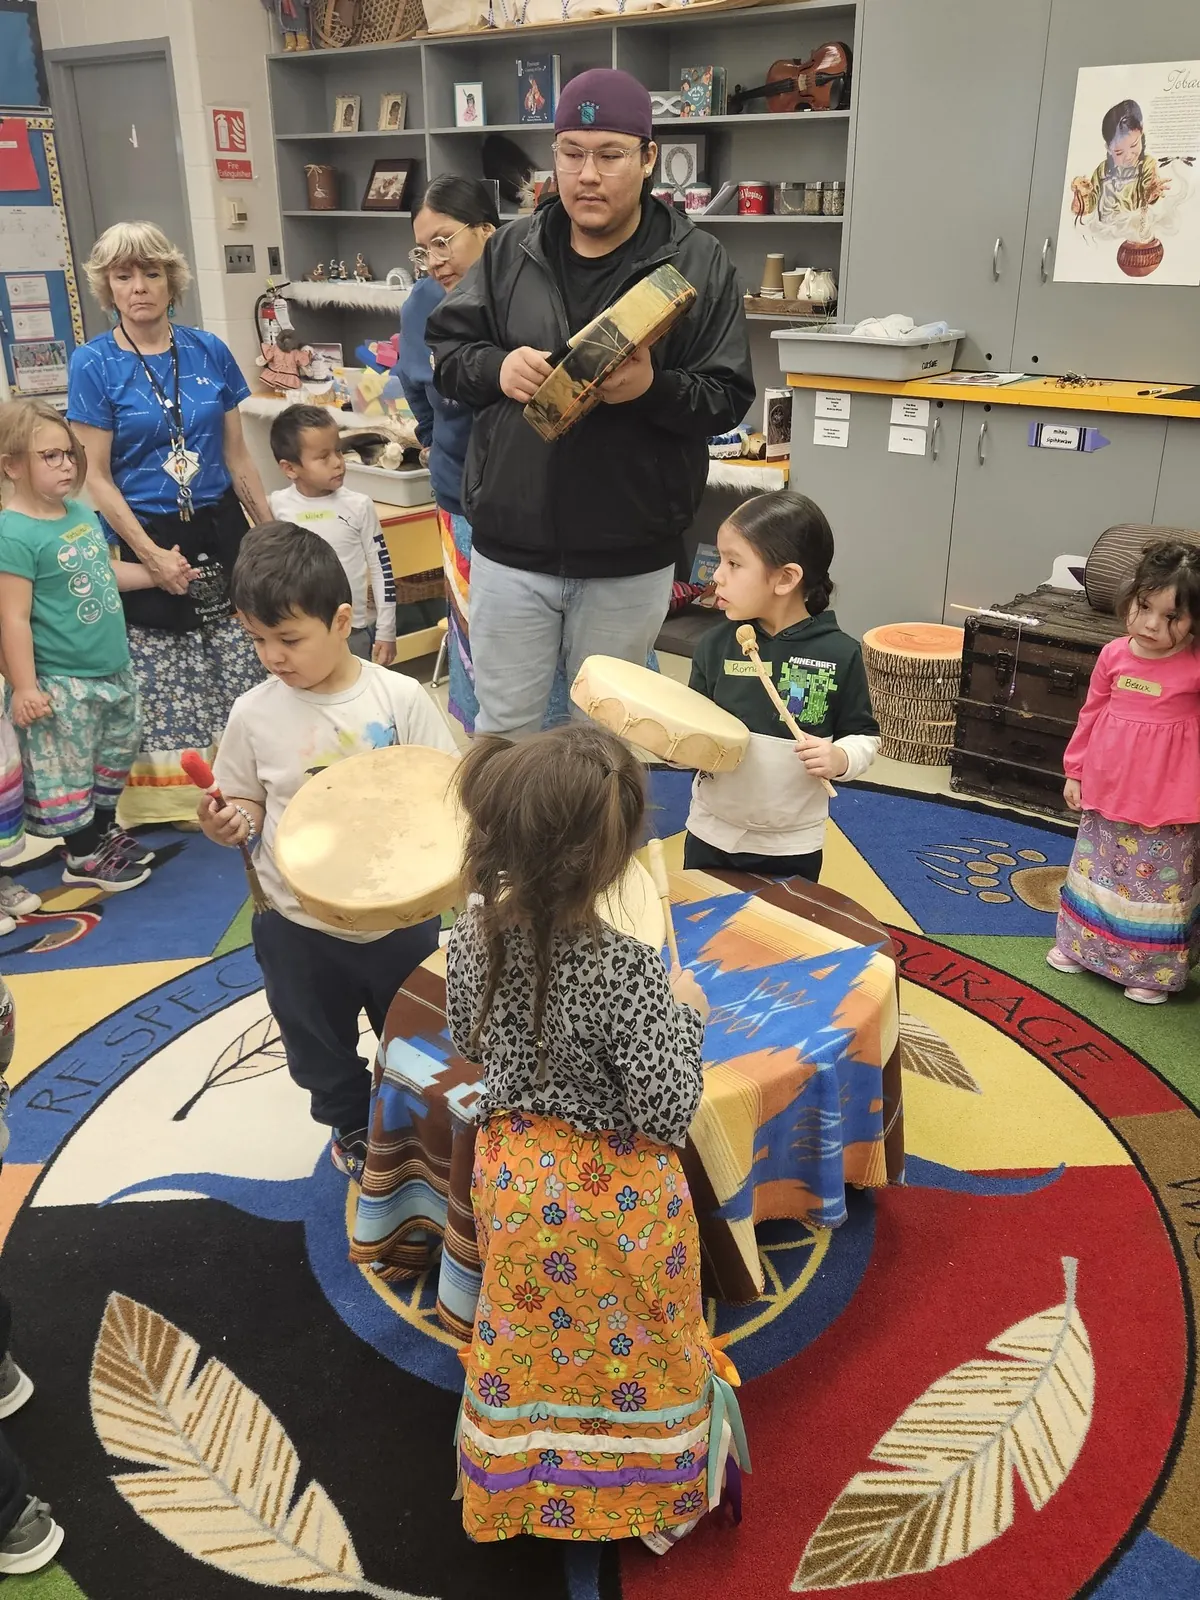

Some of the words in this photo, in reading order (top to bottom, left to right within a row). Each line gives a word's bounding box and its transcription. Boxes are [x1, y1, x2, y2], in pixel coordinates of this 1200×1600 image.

[227, 161, 240, 169] Fire
[373, 533, 397, 603] PUMA
[788, 656, 837, 670] MINECRAFT
[1125, 679, 1151, 692] Beaux
[26, 960, 264, 1114] RESPEC
